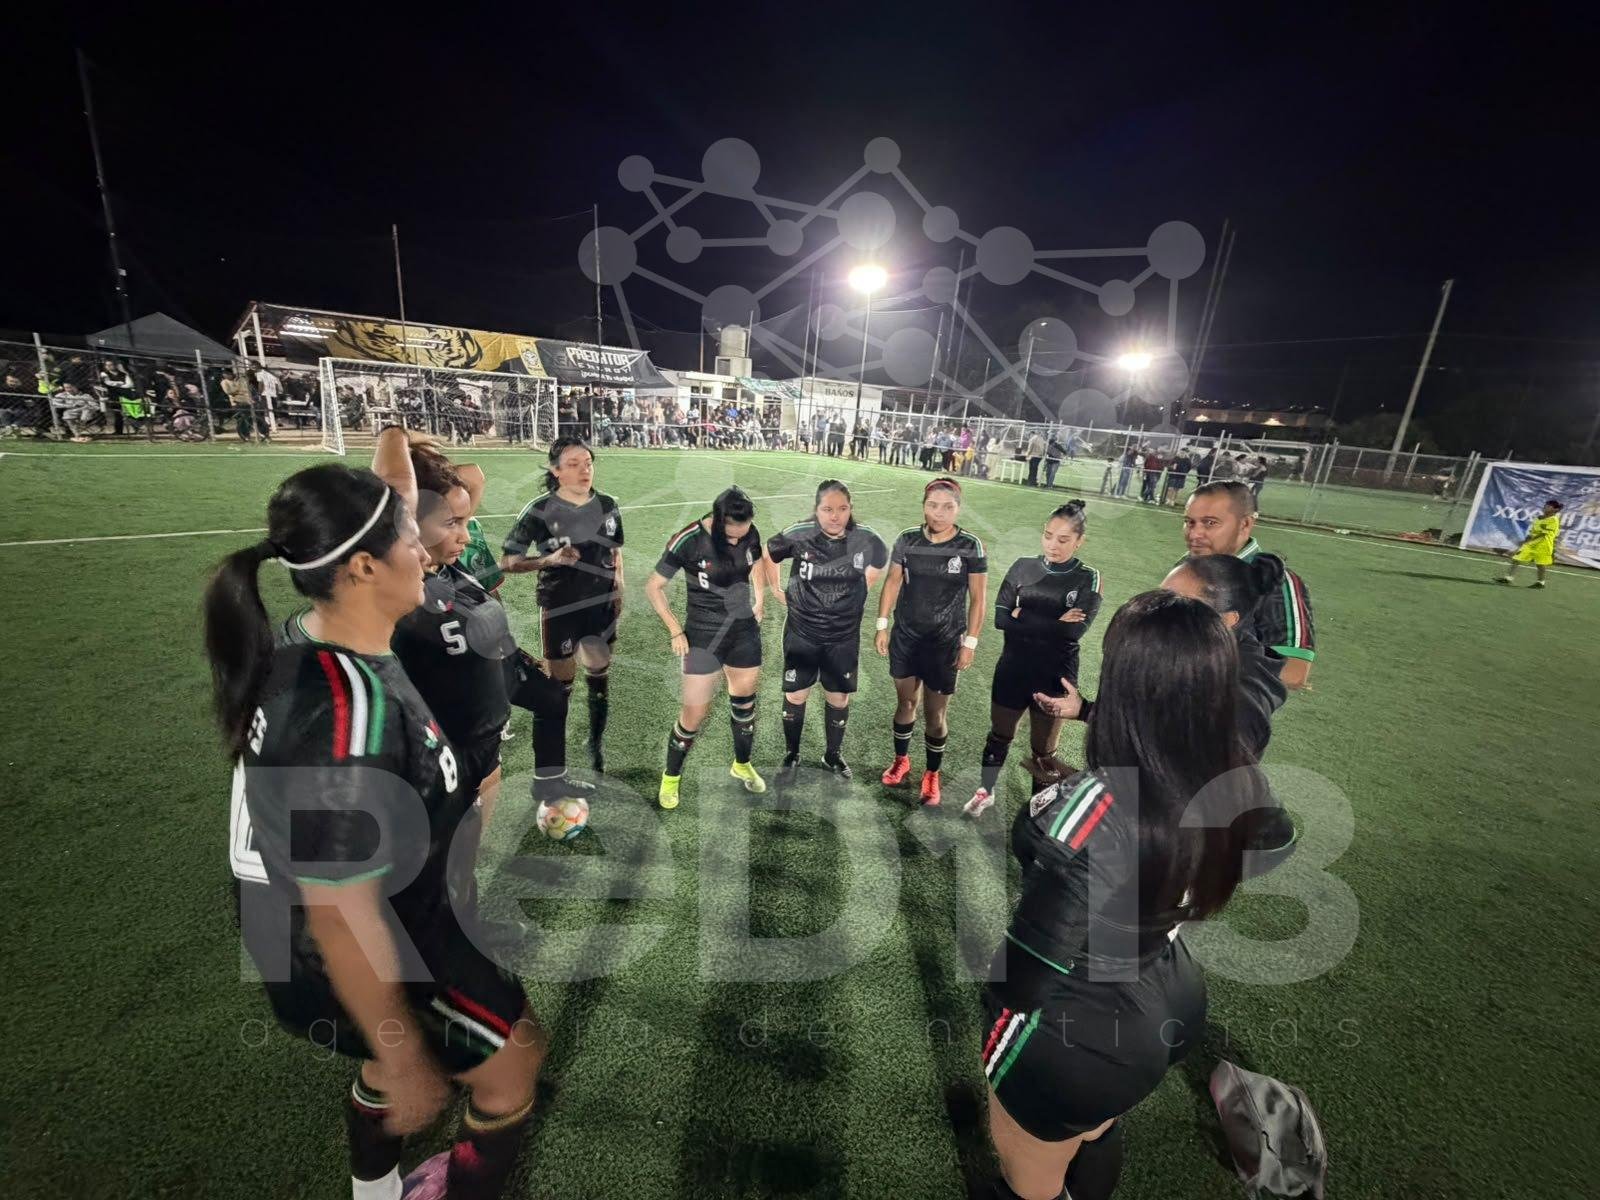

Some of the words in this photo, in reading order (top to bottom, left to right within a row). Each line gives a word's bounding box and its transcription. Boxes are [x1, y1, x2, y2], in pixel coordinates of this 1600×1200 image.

[566, 347, 631, 369] PREDATOR
[799, 561, 814, 581] 21
[440, 620, 467, 656] 5
[438, 745, 458, 793] 8
